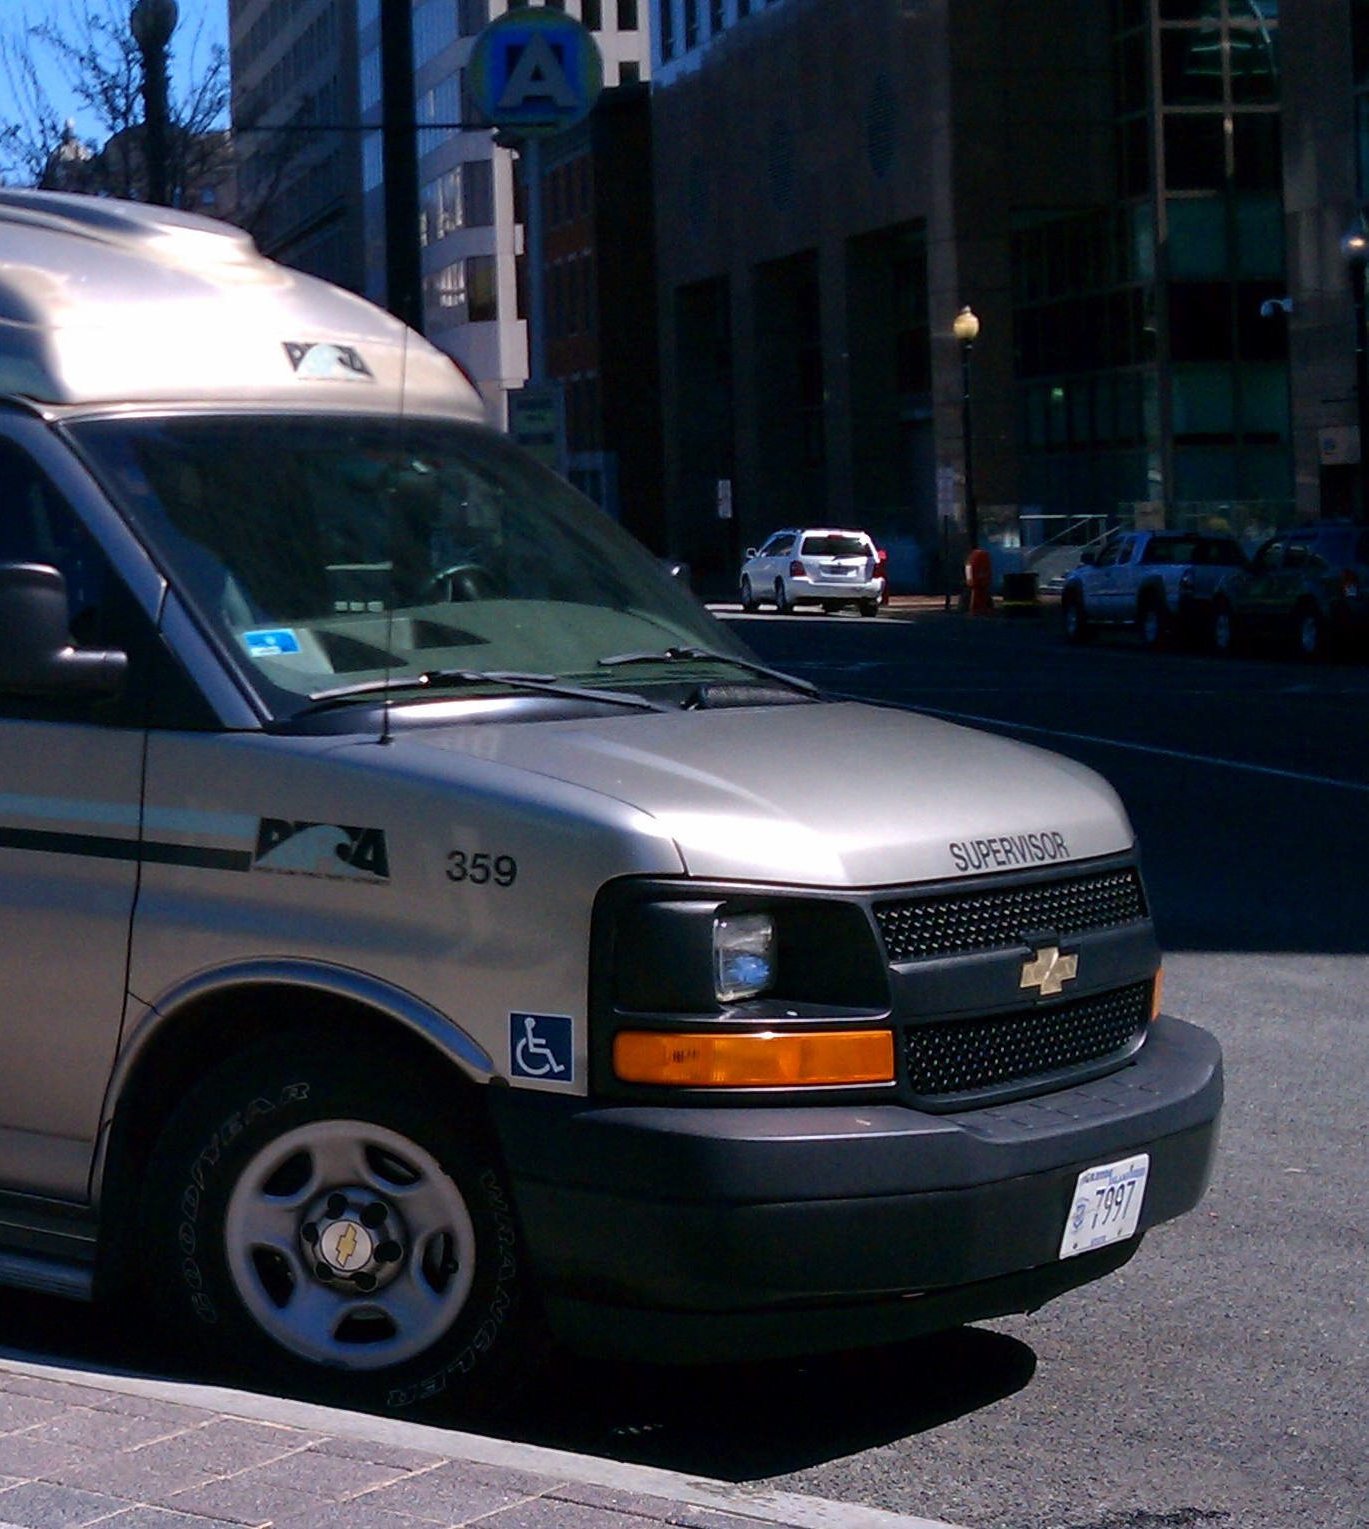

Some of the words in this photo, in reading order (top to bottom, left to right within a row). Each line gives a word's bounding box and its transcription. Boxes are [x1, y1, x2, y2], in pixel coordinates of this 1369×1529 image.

[497, 28, 578, 108] A
[446, 850, 517, 887] 359
[949, 831, 1070, 872] SUPERVISOR
[177, 1081, 310, 1324] GOODYEAR
[1091, 1180, 1136, 1230] 7997
[387, 1169, 518, 1407] WRANGLER
